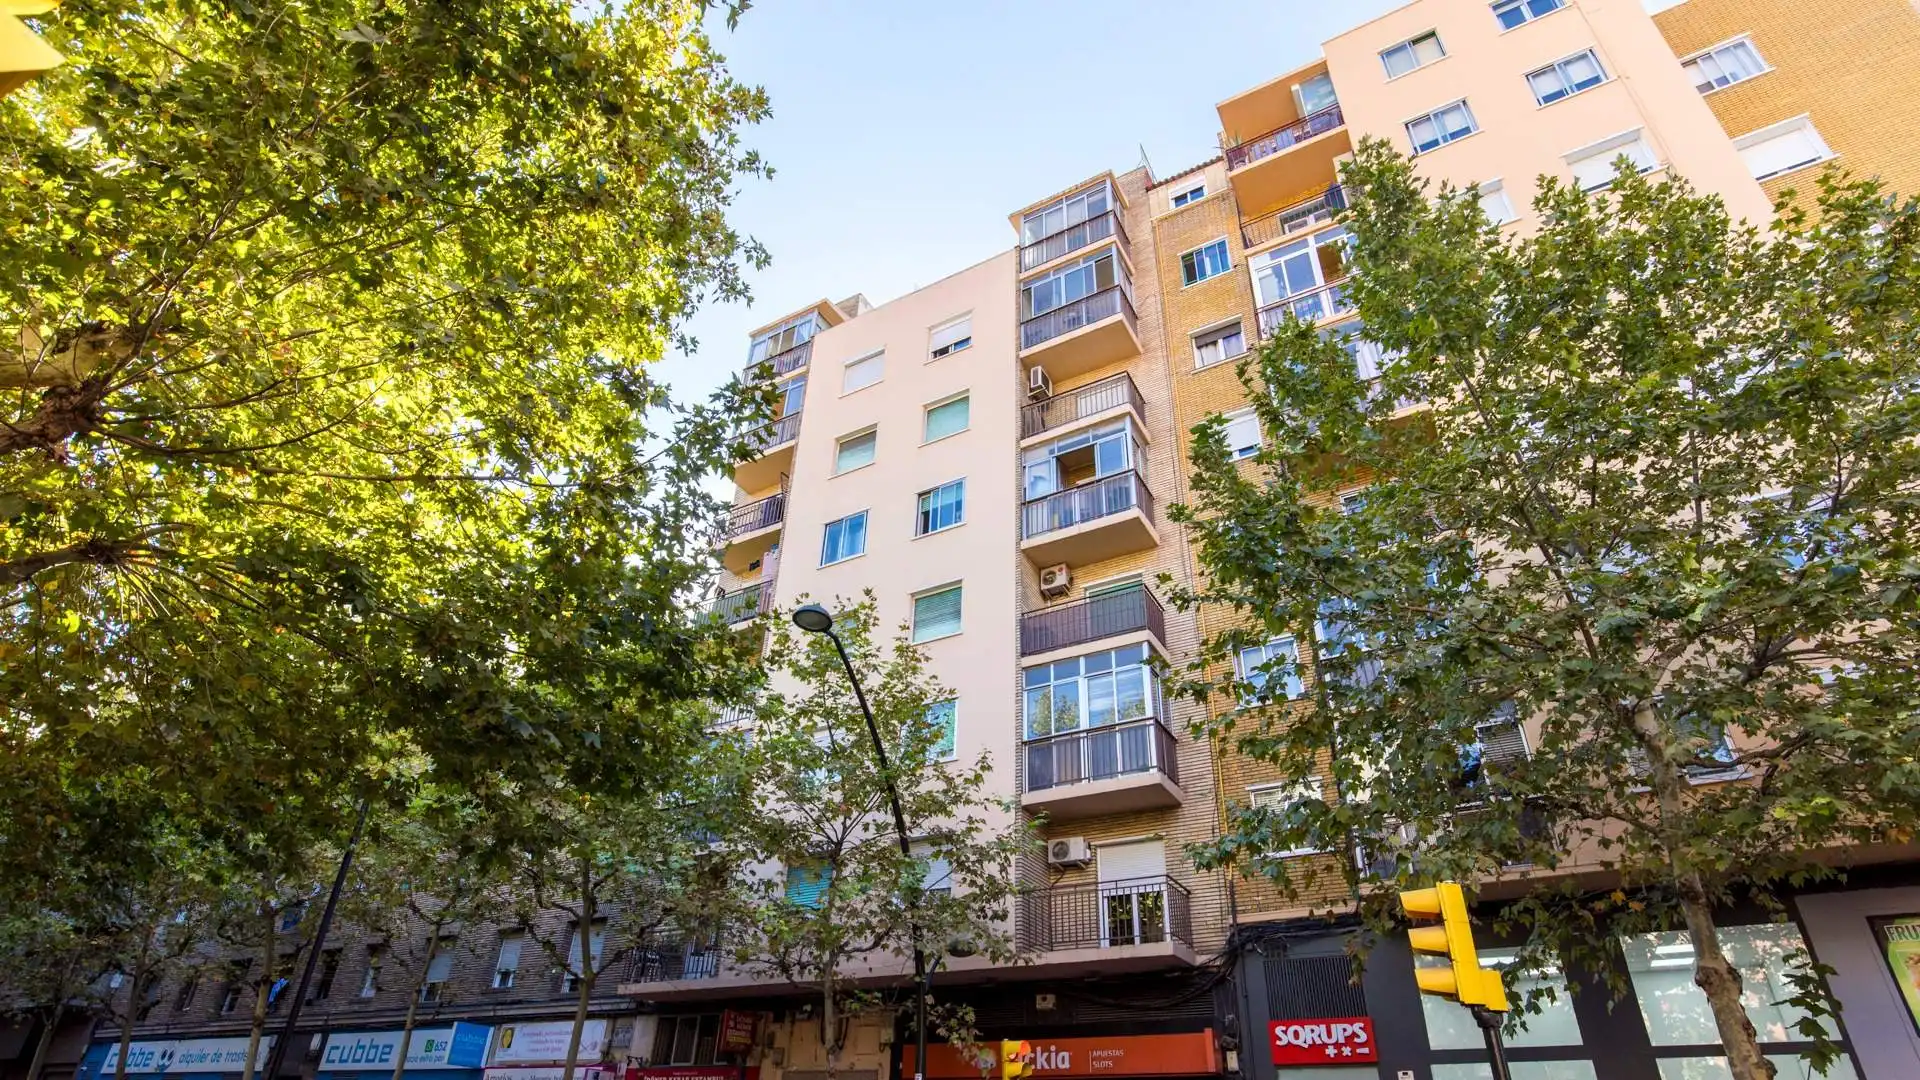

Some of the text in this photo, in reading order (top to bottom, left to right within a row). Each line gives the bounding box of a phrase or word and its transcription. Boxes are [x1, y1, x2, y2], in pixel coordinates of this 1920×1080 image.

[1886, 925, 1920, 941] FRU
[1275, 1022, 1368, 1048] SQRUPS
[107, 1047, 155, 1067] cbbe
[211, 1048, 221, 1063] de
[325, 1038, 394, 1064] cubbe
[1018, 1045, 1070, 1069] ckia
[1092, 1049, 1124, 1058] APUESTAS
[1092, 1060, 1114, 1068] SLOTS
